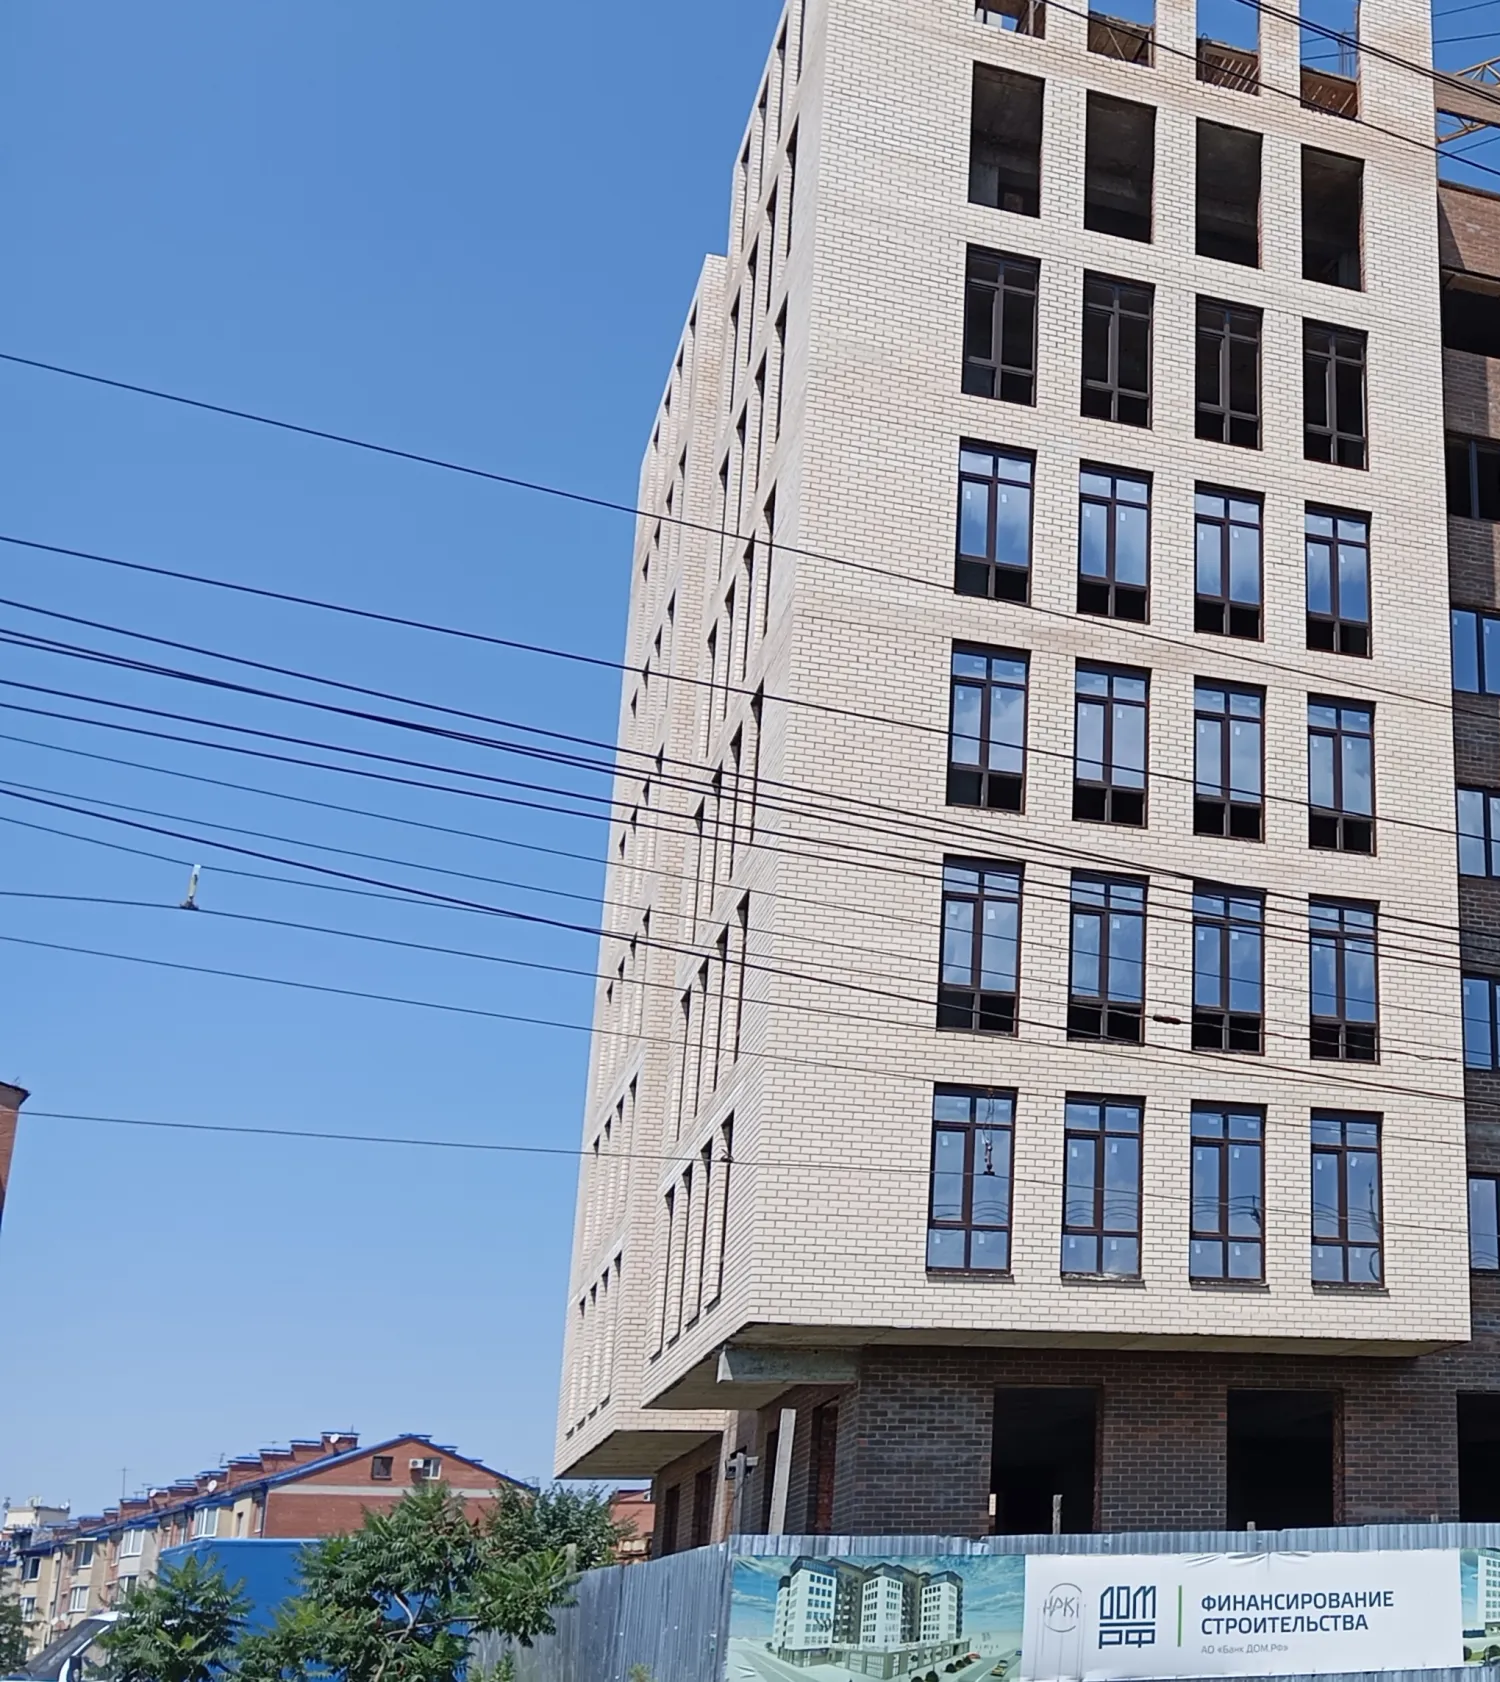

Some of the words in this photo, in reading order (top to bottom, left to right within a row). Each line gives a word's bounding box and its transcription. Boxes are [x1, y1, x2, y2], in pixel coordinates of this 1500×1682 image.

[1099, 1585, 1156, 1620] ДОМ
[1201, 1591, 1394, 1612] ФИНАНСИРОВАНИЕ
[1201, 1614, 1369, 1635] СТРОИТЕЛЬСТВА
[1098, 1628, 1156, 1650] РФ
[1201, 1644, 1215, 1655] АО
[1217, 1644, 1244, 1654] «Банк
